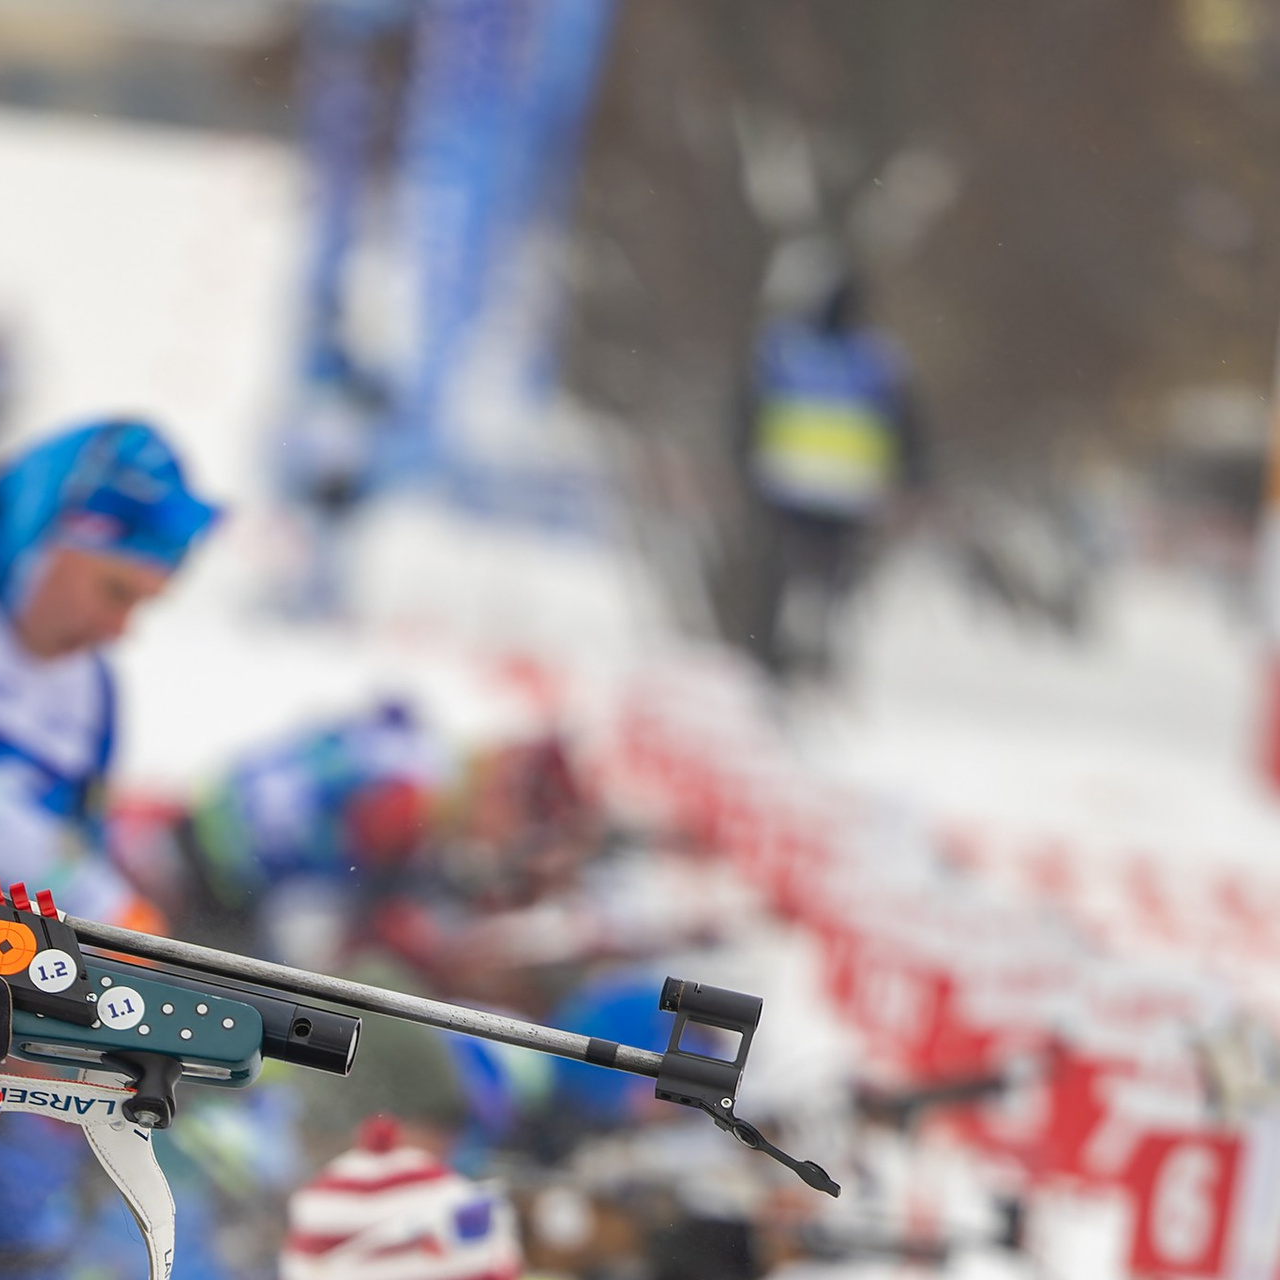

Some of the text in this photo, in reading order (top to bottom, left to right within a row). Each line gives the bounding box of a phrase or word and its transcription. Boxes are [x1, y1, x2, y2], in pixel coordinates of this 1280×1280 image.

[38, 961, 68, 982] 1.2
[107, 998, 135, 1019] 1.1
[1, 1086, 116, 1116] LARSE
